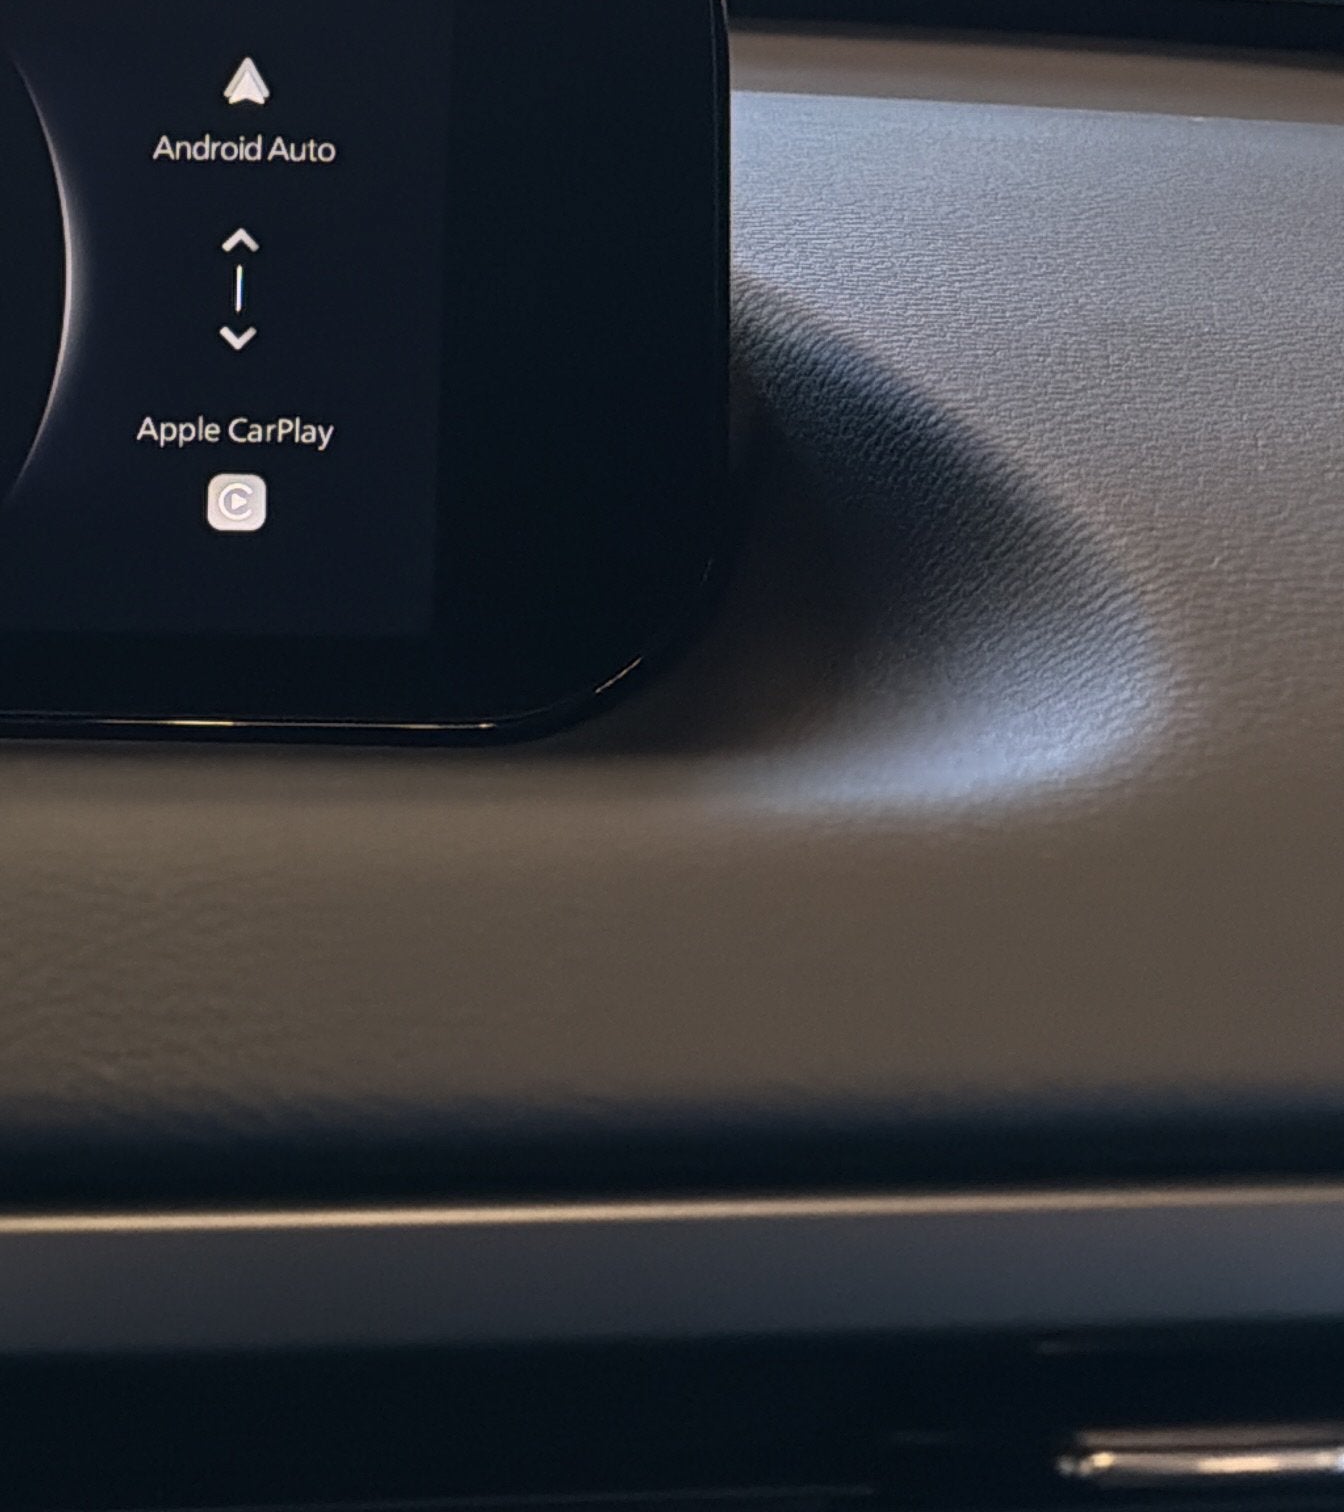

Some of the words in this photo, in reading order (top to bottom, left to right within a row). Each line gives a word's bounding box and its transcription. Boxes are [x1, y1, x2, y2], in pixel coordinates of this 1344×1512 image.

[152, 133, 263, 162] Android
[267, 136, 336, 163] Auto
[136, 415, 221, 446] Apple
[227, 416, 335, 450] CarPlay
